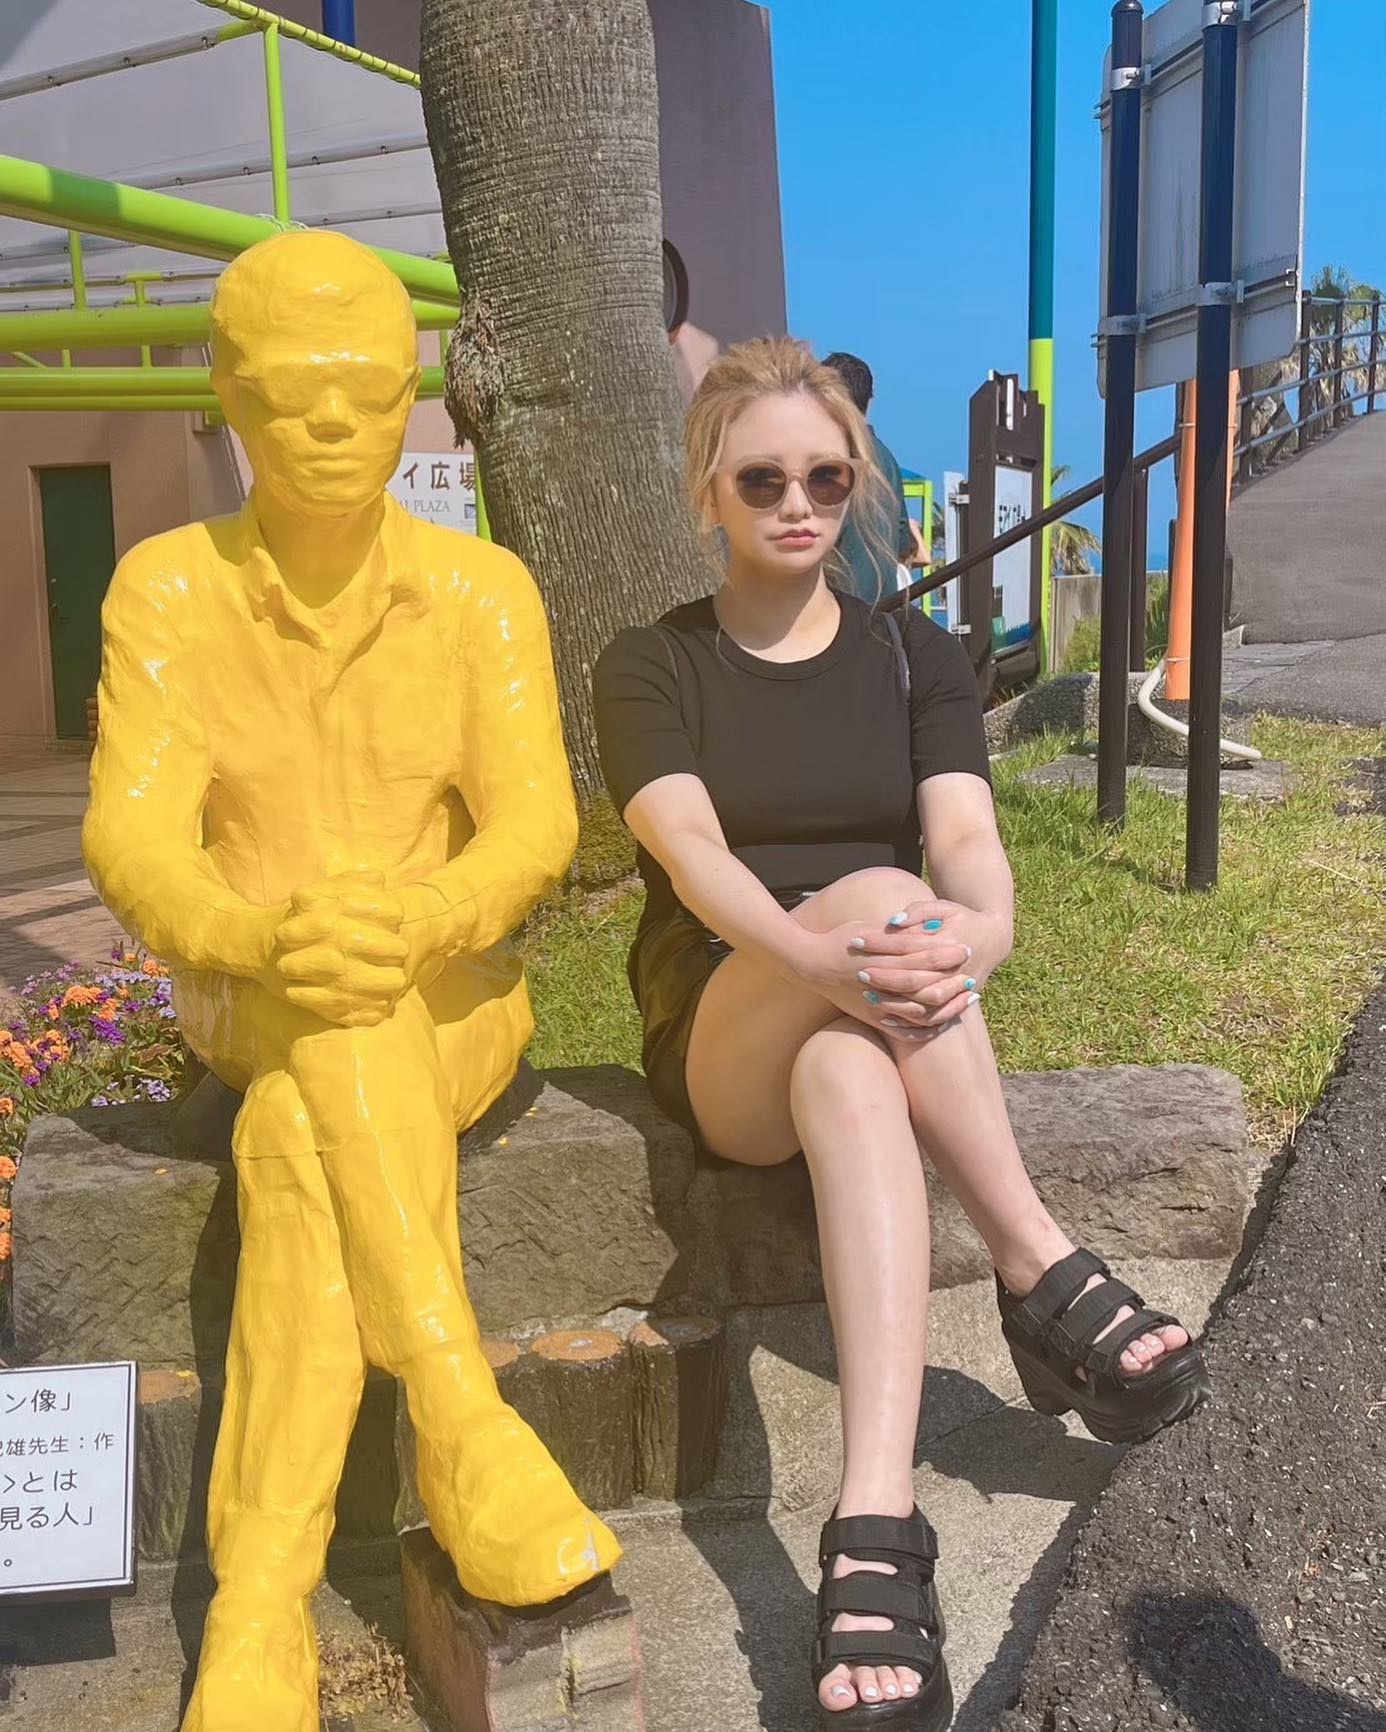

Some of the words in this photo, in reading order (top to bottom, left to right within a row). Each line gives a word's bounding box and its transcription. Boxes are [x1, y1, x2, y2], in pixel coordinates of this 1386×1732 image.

[413, 499, 451, 513] PLAZA
[0, 1432, 115, 1457] 雄先生：作
[0, 1501, 93, 1531] 見る人」
